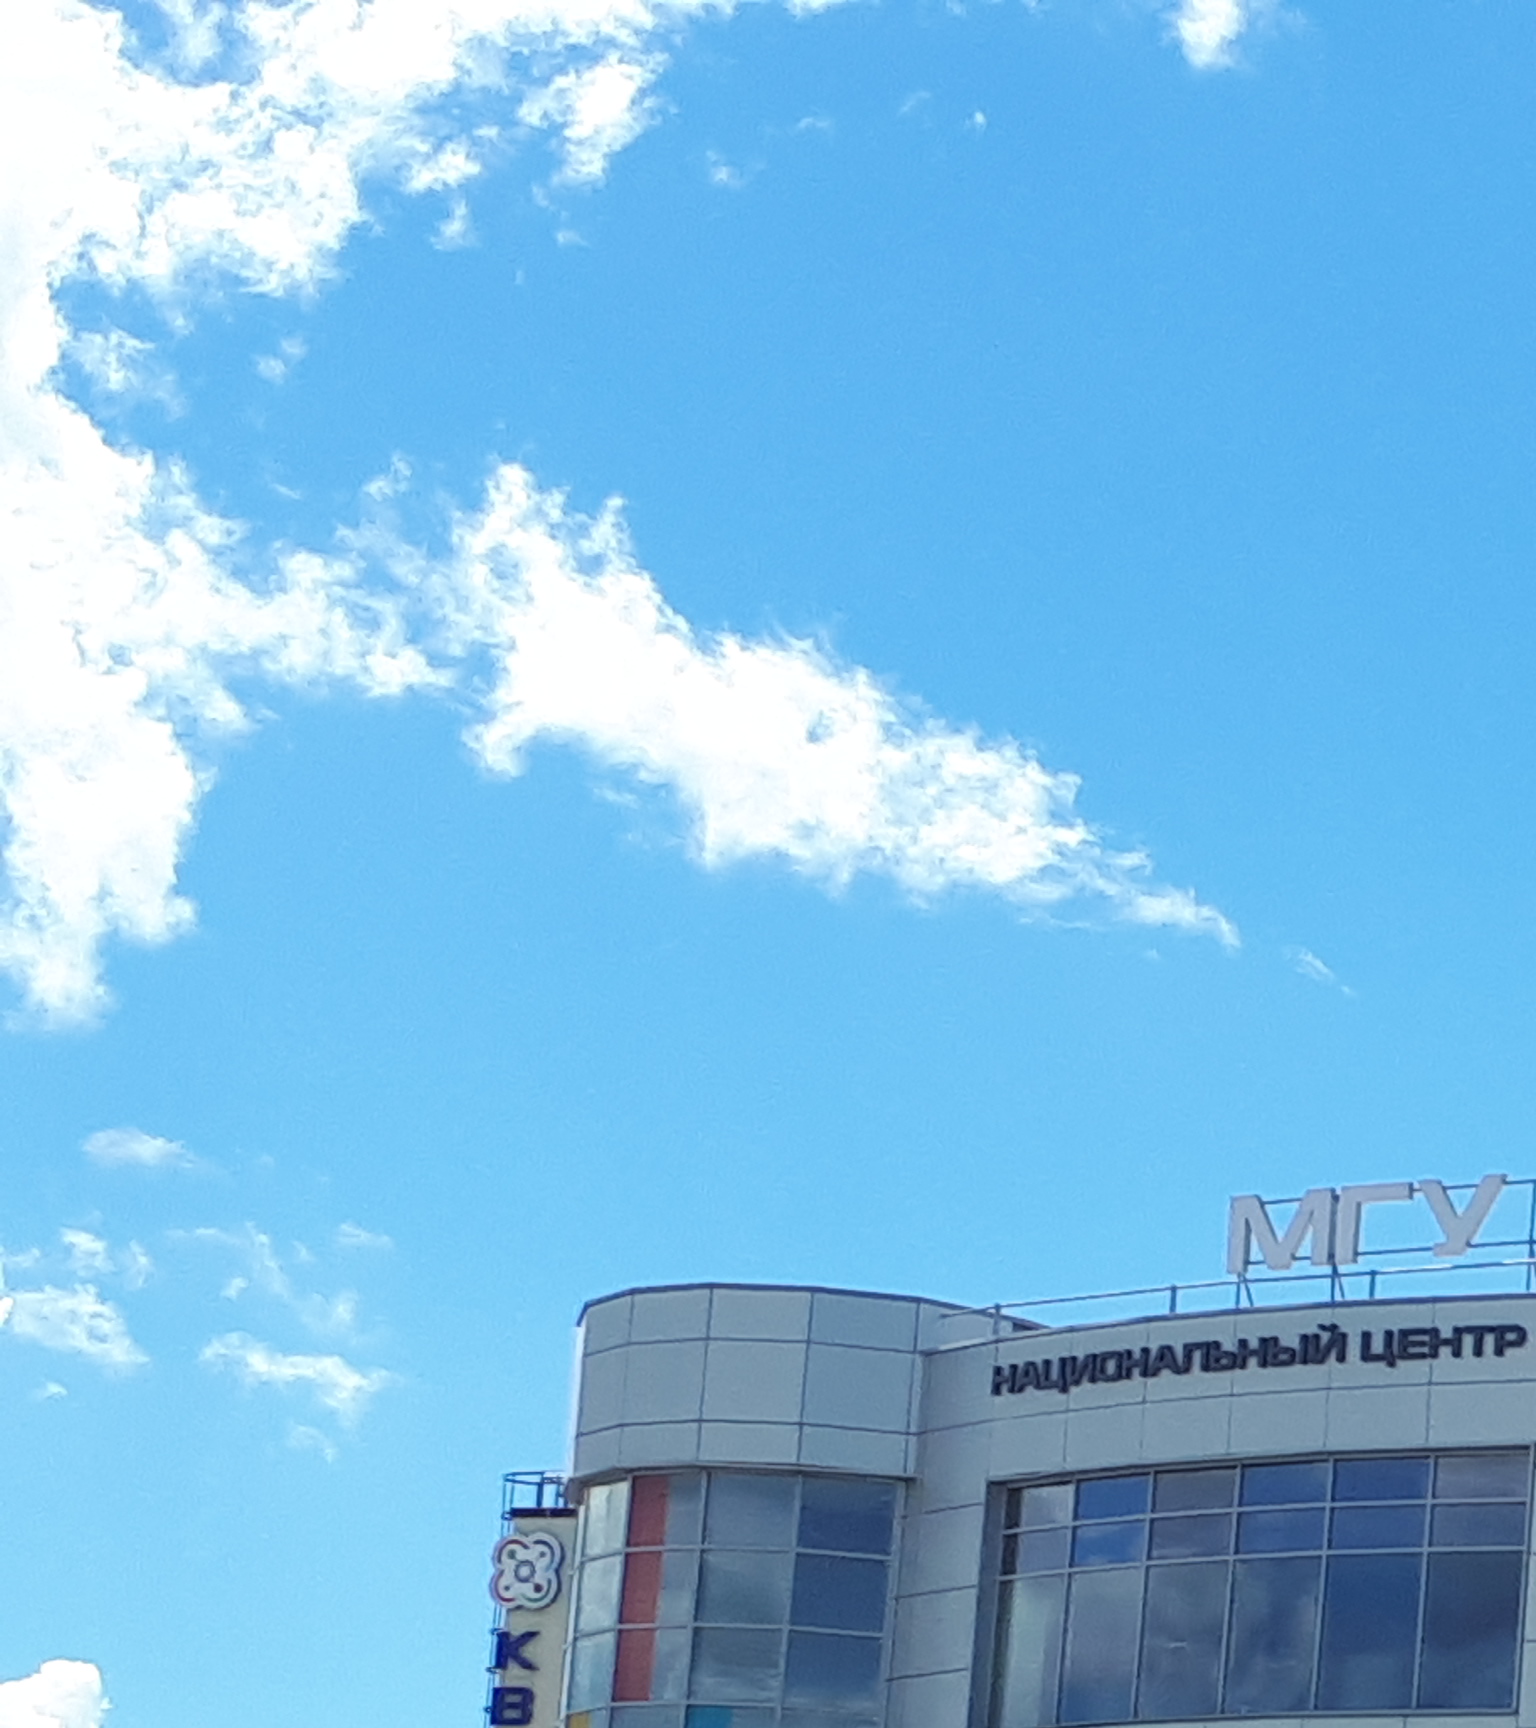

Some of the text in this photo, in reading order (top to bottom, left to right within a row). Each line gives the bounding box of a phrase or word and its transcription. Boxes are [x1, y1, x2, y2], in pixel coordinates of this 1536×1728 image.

[1228, 1174, 1507, 1273] МГУ
[992, 1324, 1347, 1395] НАЦИОНАЛЬНЫЙ
[1360, 1324, 1526, 1367] ЦЕНТР
